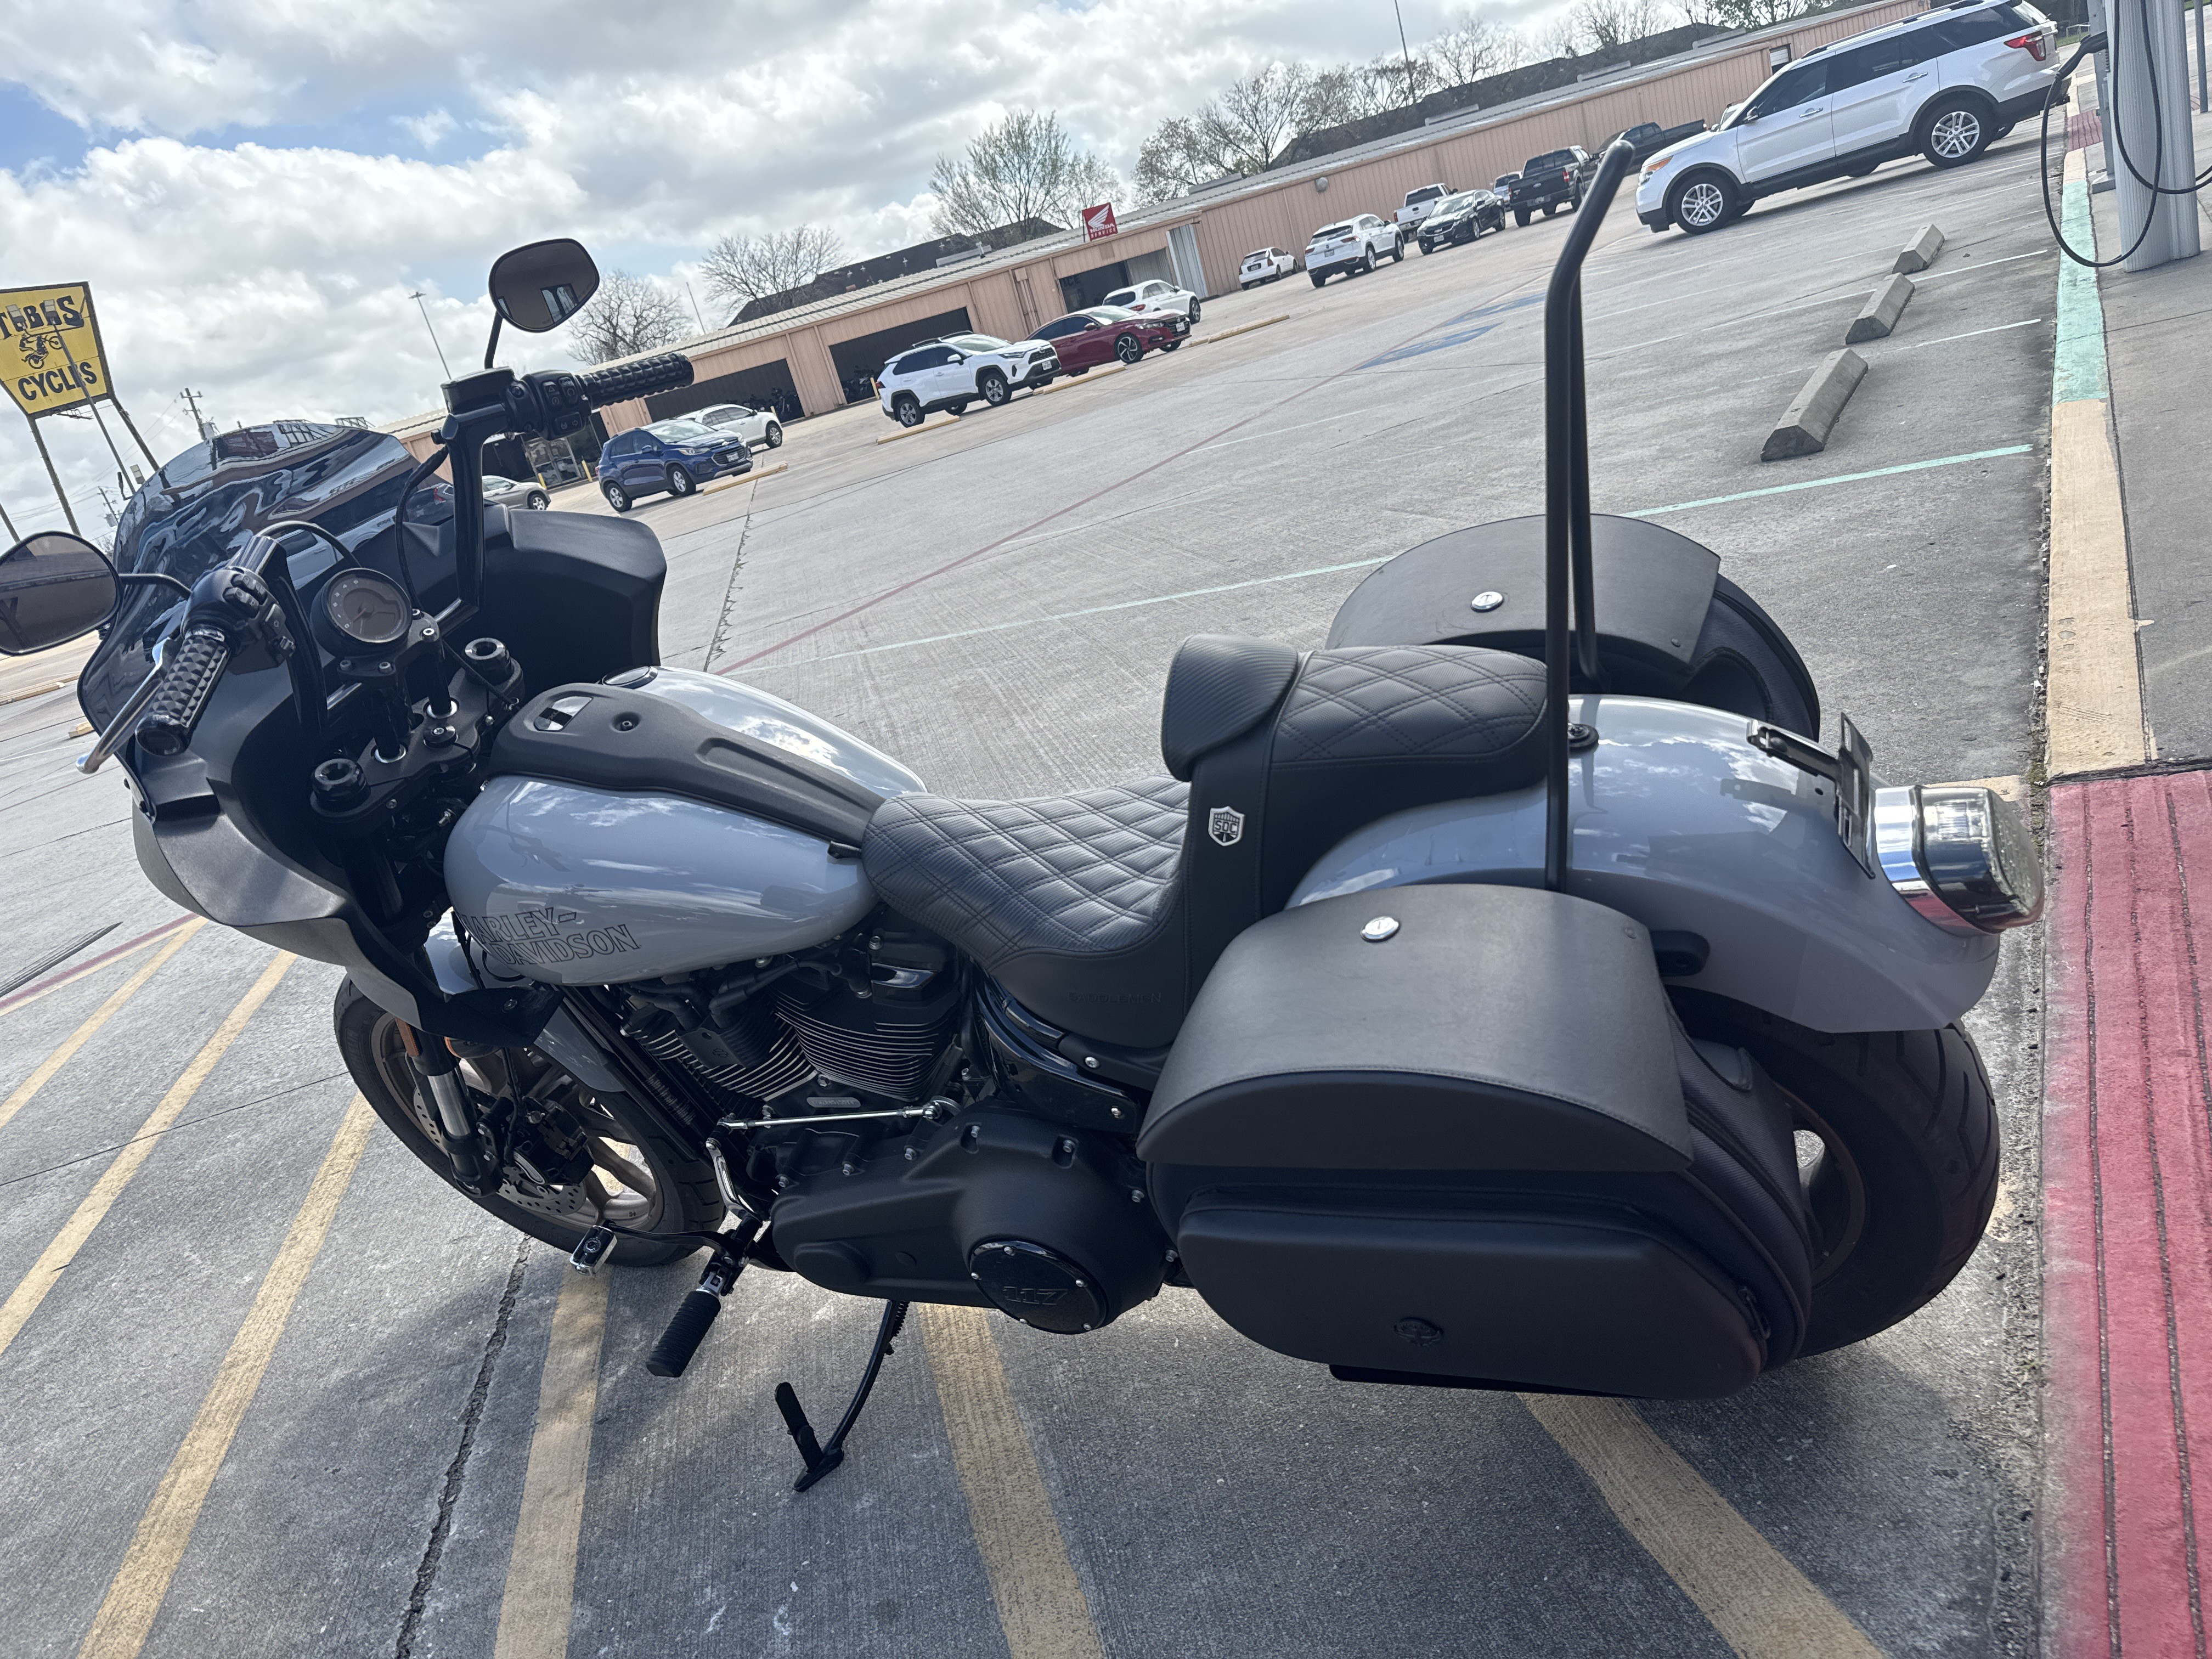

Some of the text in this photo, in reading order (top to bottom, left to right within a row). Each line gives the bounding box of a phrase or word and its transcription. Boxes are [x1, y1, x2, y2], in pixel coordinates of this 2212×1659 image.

[1090, 223, 1115, 233] HONDA
[1091, 227, 1116, 238] SERVICE
[489, 924, 640, 964] DAVIDSON
[1002, 1286, 1068, 1305] 117
